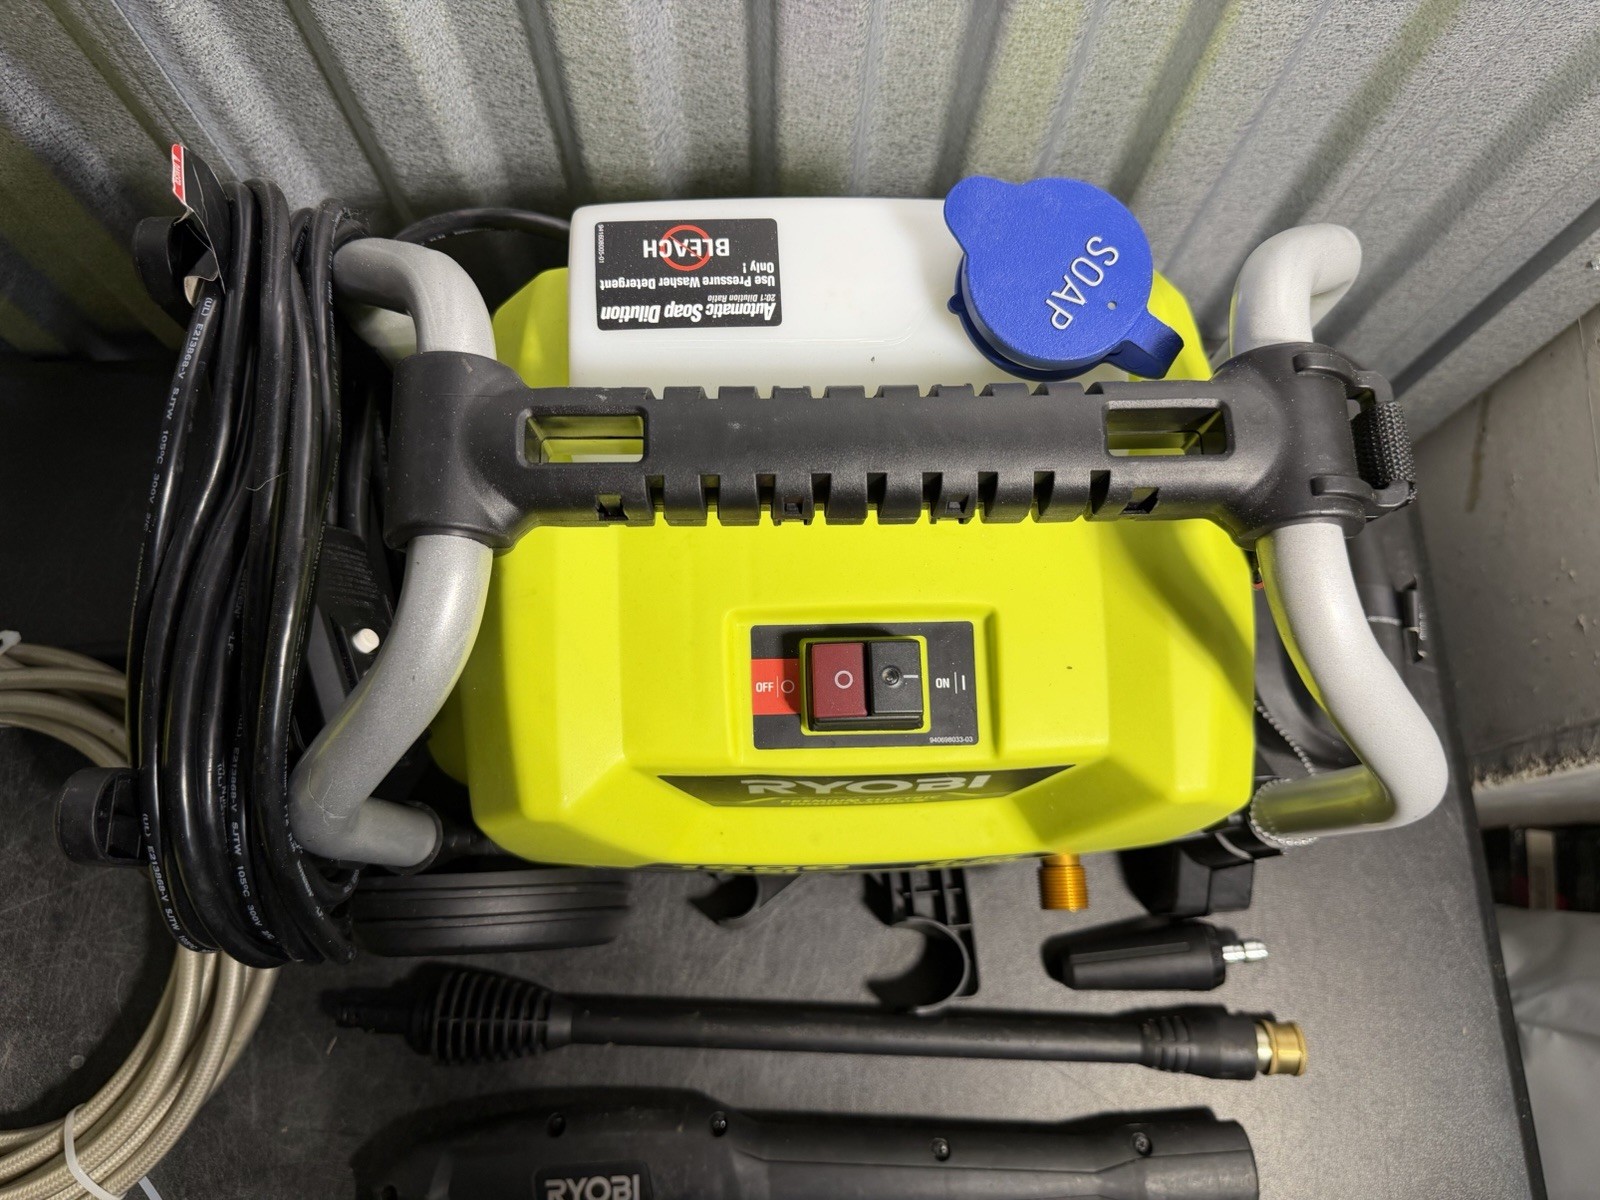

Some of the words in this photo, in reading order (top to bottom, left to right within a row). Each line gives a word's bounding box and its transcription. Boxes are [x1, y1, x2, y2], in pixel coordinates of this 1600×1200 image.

[642, 238, 730, 258] BLEACH
[750, 259, 775, 273] Only
[599, 277, 657, 290] Detergent
[658, 276, 701, 288] Washer
[702, 275, 752, 287] Pressure
[754, 275, 776, 287] Use
[1045, 235, 1119, 330] SOAP
[707, 294, 729, 303] Ratio
[729, 294, 759, 302] Dilution
[760, 293, 777, 302] 20:1
[600, 304, 662, 324] Dilution
[664, 300, 704, 322] Soap
[704, 302, 777, 321] Automatic
[165, 387, 180, 421] SJTW
[755, 680, 774, 693] OFF
[935, 677, 950, 689] ON
[740, 774, 993, 795] RYOBI
[231, 820, 243, 856] SJTW
[146, 844, 169, 902] E213868-V
[164, 907, 181, 931] SJTW
[544, 1174, 641, 1200] RYOBI
